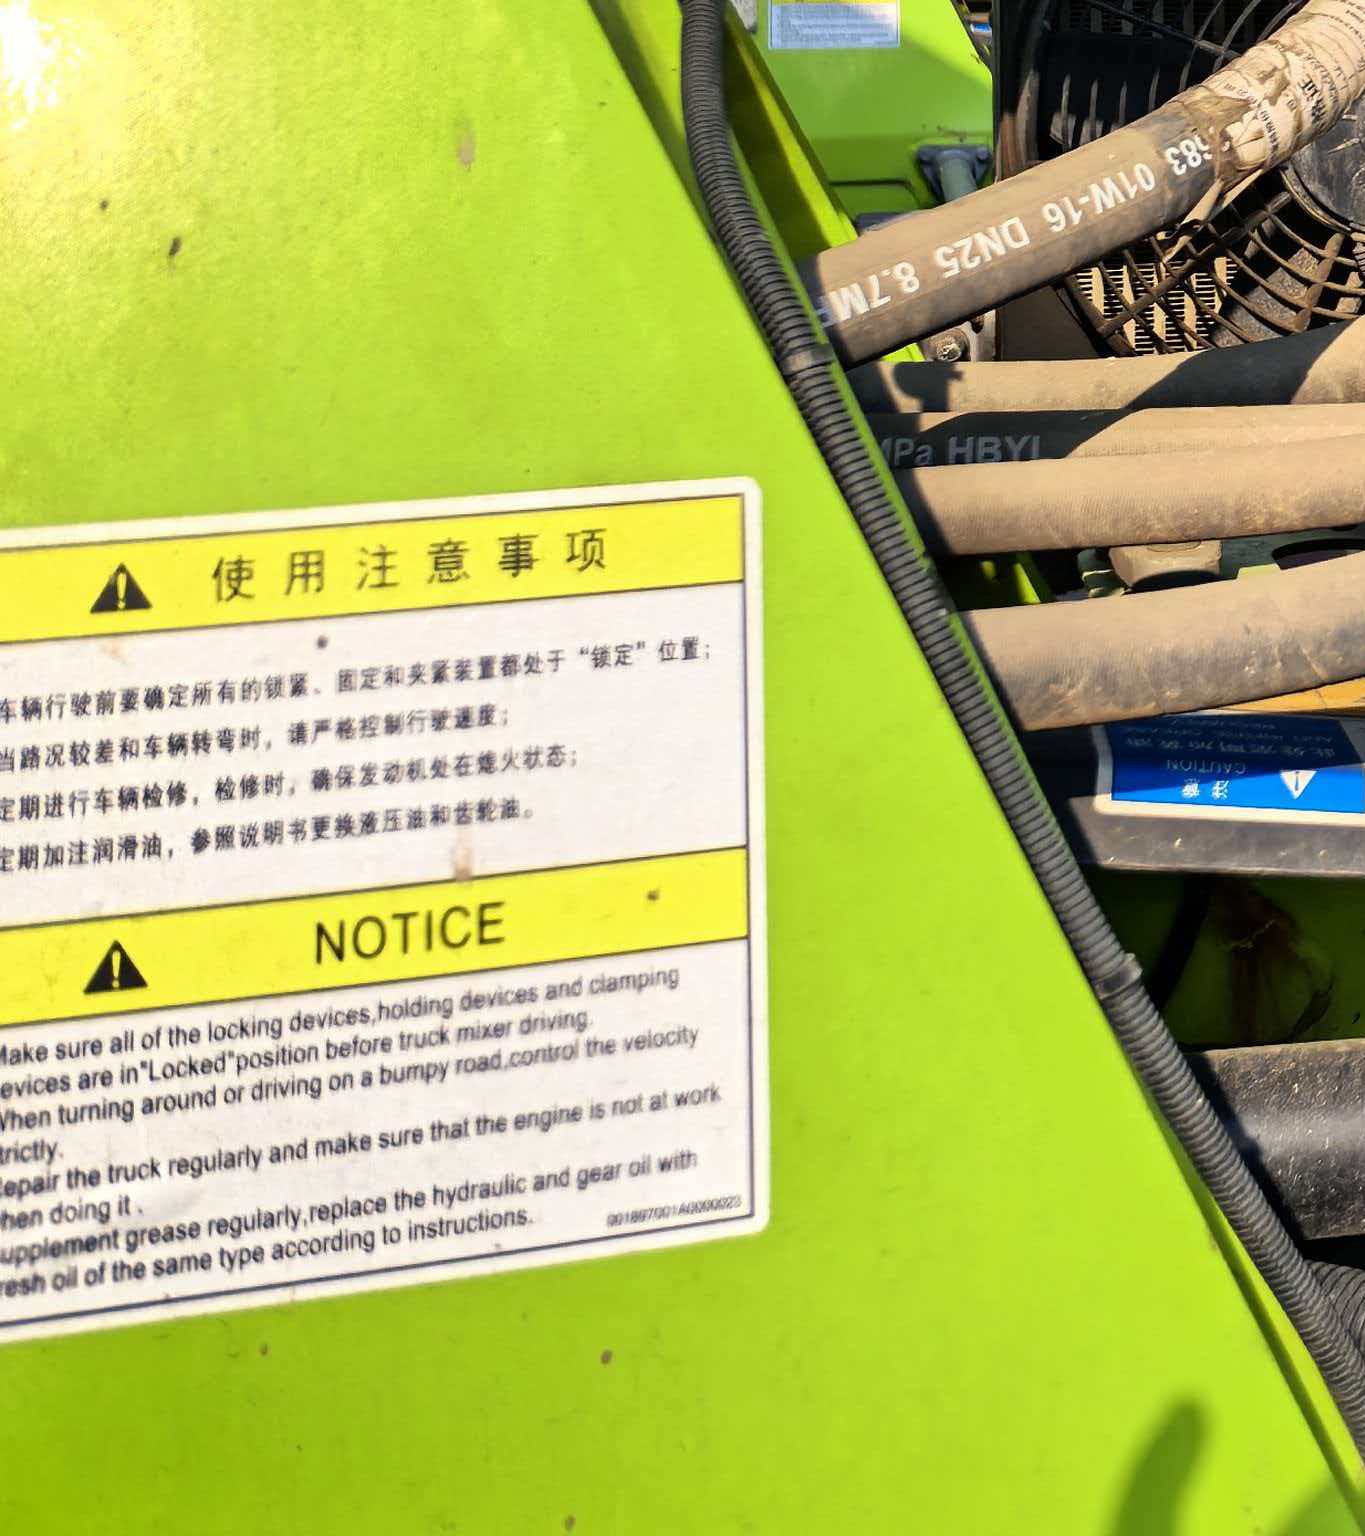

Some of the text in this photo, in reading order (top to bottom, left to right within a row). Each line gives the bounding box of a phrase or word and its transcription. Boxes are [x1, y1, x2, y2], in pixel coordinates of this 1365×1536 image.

[1041, 162, 1156, 233] 01W-16
[933, 216, 1031, 279] DN25
[211, 526, 609, 603] 使用注意事项
[313, 902, 506, 965] NOTICE
[55, 1039, 103, 1060] sure
[110, 1030, 134, 1054] all
[142, 1026, 162, 1050] of
[169, 1026, 201, 1047] the
[208, 1018, 282, 1042] locking
[460, 988, 538, 1011] devices
[545, 979, 582, 1000] and
[590, 970, 679, 994] clamping
[0, 1075, 71, 1100] evices
[78, 1070, 113, 1090] are
[326, 1036, 392, 1059] before
[400, 1026, 450, 1050] truck
[456, 1022, 512, 1042] mixer
[58, 1100, 134, 1124] turning
[142, 1087, 216, 1114] around
[224, 1086, 245, 1104] or
[252, 1077, 322, 1101] driving
[329, 1073, 354, 1091] on
[361, 1070, 373, 1087] a
[379, 1062, 449, 1085] bumpy
[586, 1039, 616, 1057] the
[624, 1028, 698, 1050] velocity
[66, 1168, 101, 1189] the
[108, 1158, 161, 1183] truck
[169, 1148, 262, 1178] regularly
[270, 1138, 308, 1162] and
[315, 1134, 372, 1156] make
[378, 1128, 424, 1148] sure
[430, 1119, 469, 1141] that
[476, 1116, 508, 1135] the
[514, 1107, 583, 1132] engine
[590, 1103, 605, 1119] is
[612, 1096, 643, 1115] not
[650, 1092, 667, 1111] at
[674, 1086, 721, 1106] work
[0, 1230, 120, 1264] upplement
[126, 1222, 201, 1249] grease
[394, 1190, 426, 1209] the
[433, 1176, 526, 1207] hydraulic
[533, 1168, 570, 1191] and
[576, 1164, 622, 1190] gear
[629, 1156, 651, 1177] oil
[658, 1151, 696, 1172] with
[0, 1210, 43, 1230] hen
[50, 1201, 111, 1225] doing
[118, 1195, 131, 1216] it
[0, 1211, 533, 1297] resh oil of the same type according to instructions.
